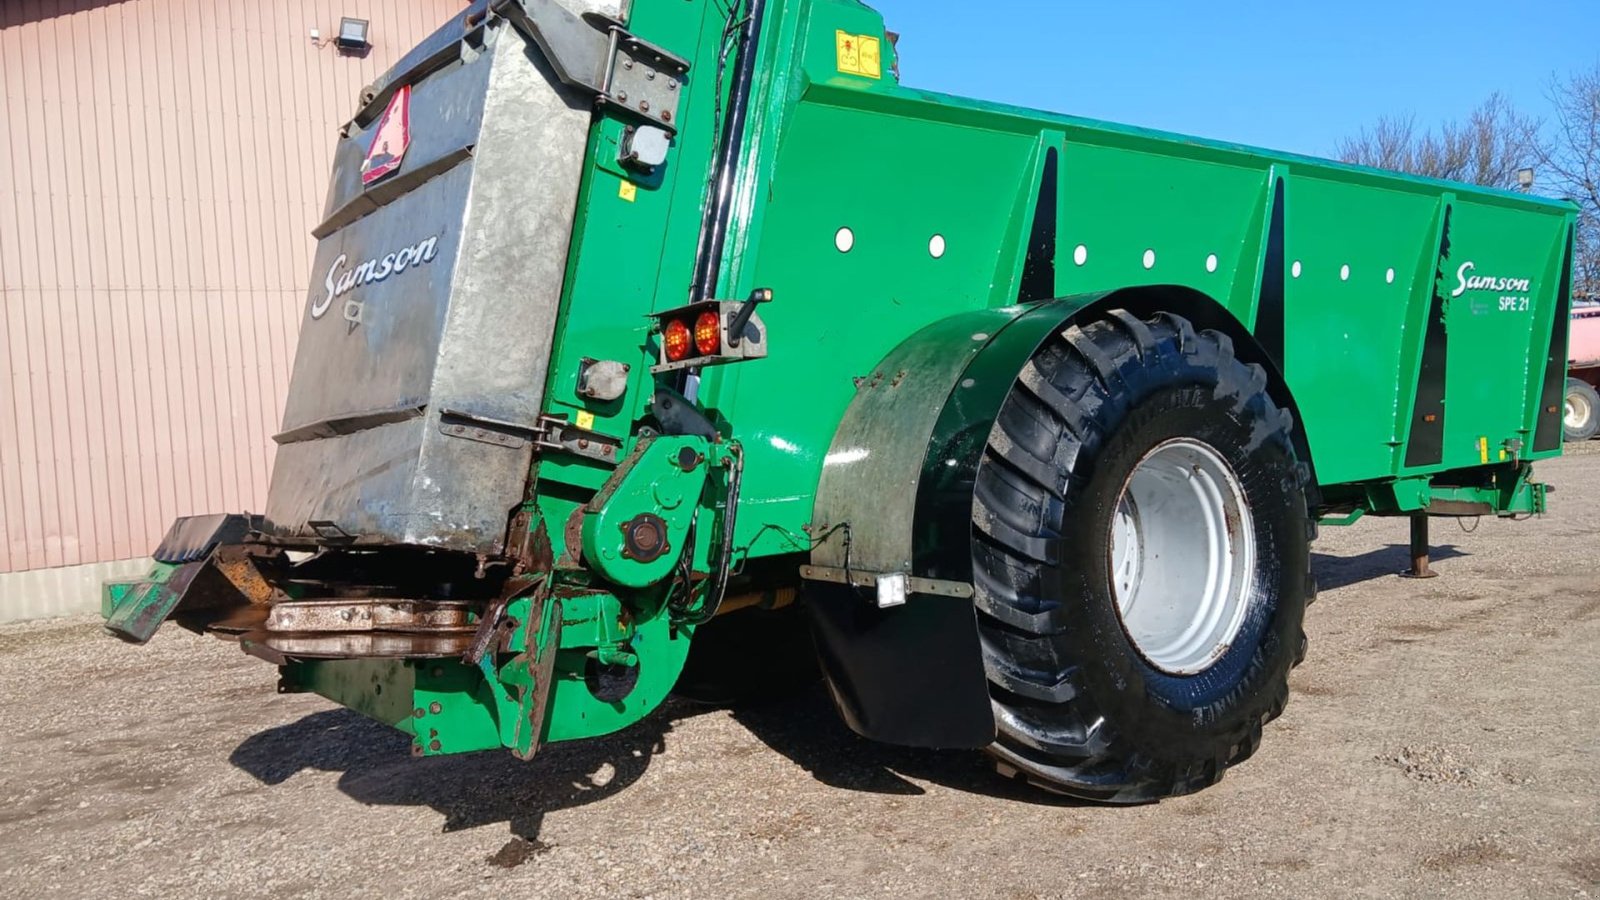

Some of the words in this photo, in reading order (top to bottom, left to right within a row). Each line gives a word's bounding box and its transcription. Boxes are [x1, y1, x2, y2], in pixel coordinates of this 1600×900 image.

[311, 235, 439, 320] Samson
[1451, 261, 1530, 297] Samson
[1498, 296, 1517, 311] SPE
[1518, 297, 1530, 311] 21
